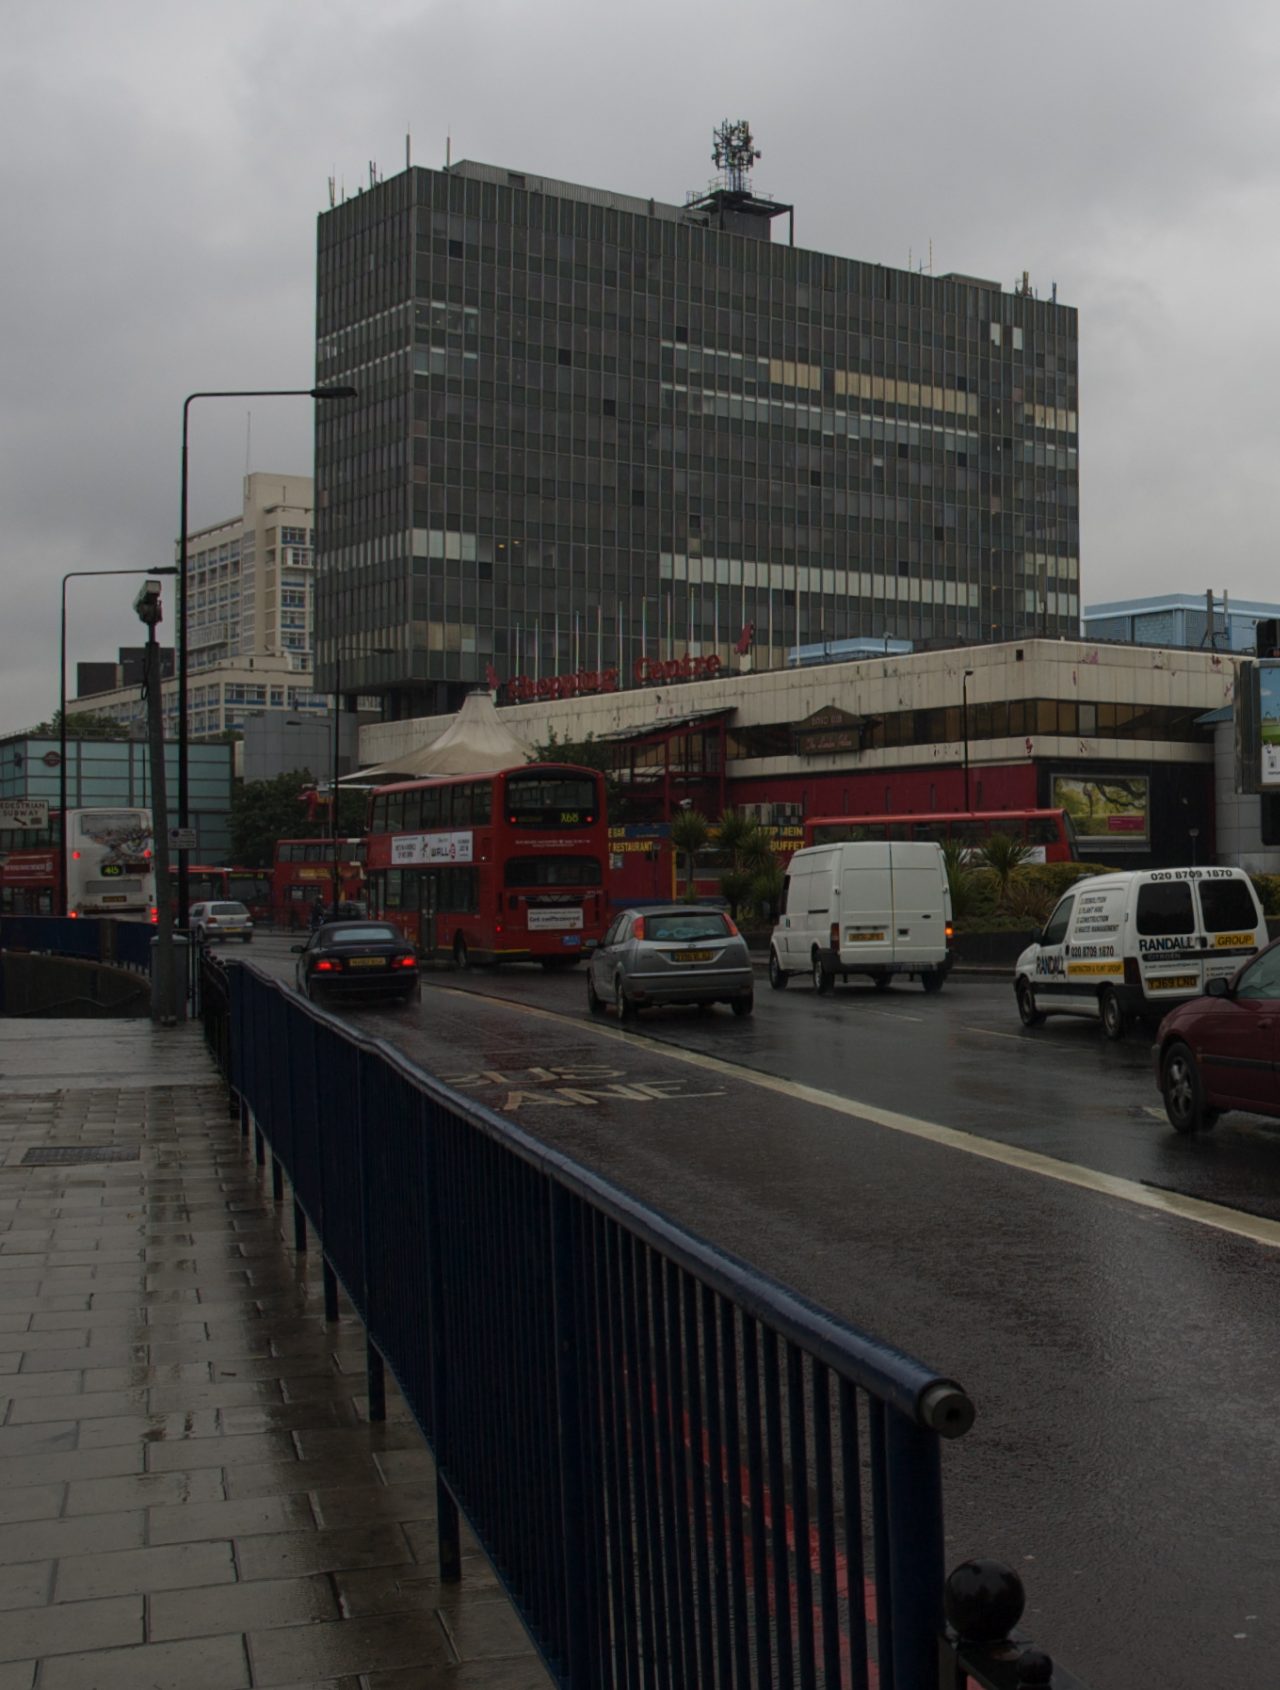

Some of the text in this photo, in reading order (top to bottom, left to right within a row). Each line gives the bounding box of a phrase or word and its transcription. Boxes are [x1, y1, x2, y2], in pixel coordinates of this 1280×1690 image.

[508, 653, 721, 699] Shopping Centre
[613, 827, 625, 838] BAR
[613, 841, 653, 853] RESTAURANT
[770, 840, 805, 851] BUFFET
[1151, 870, 1233, 881] 020 8709 1870
[1140, 935, 1252, 951] RANDALL GROUP
[1071, 946, 1114, 957] 020 8709 1870
[1036, 955, 1065, 975] RANDALL
[436, 1065, 626, 1089] BUS
[495, 1079, 728, 1111] ANE
